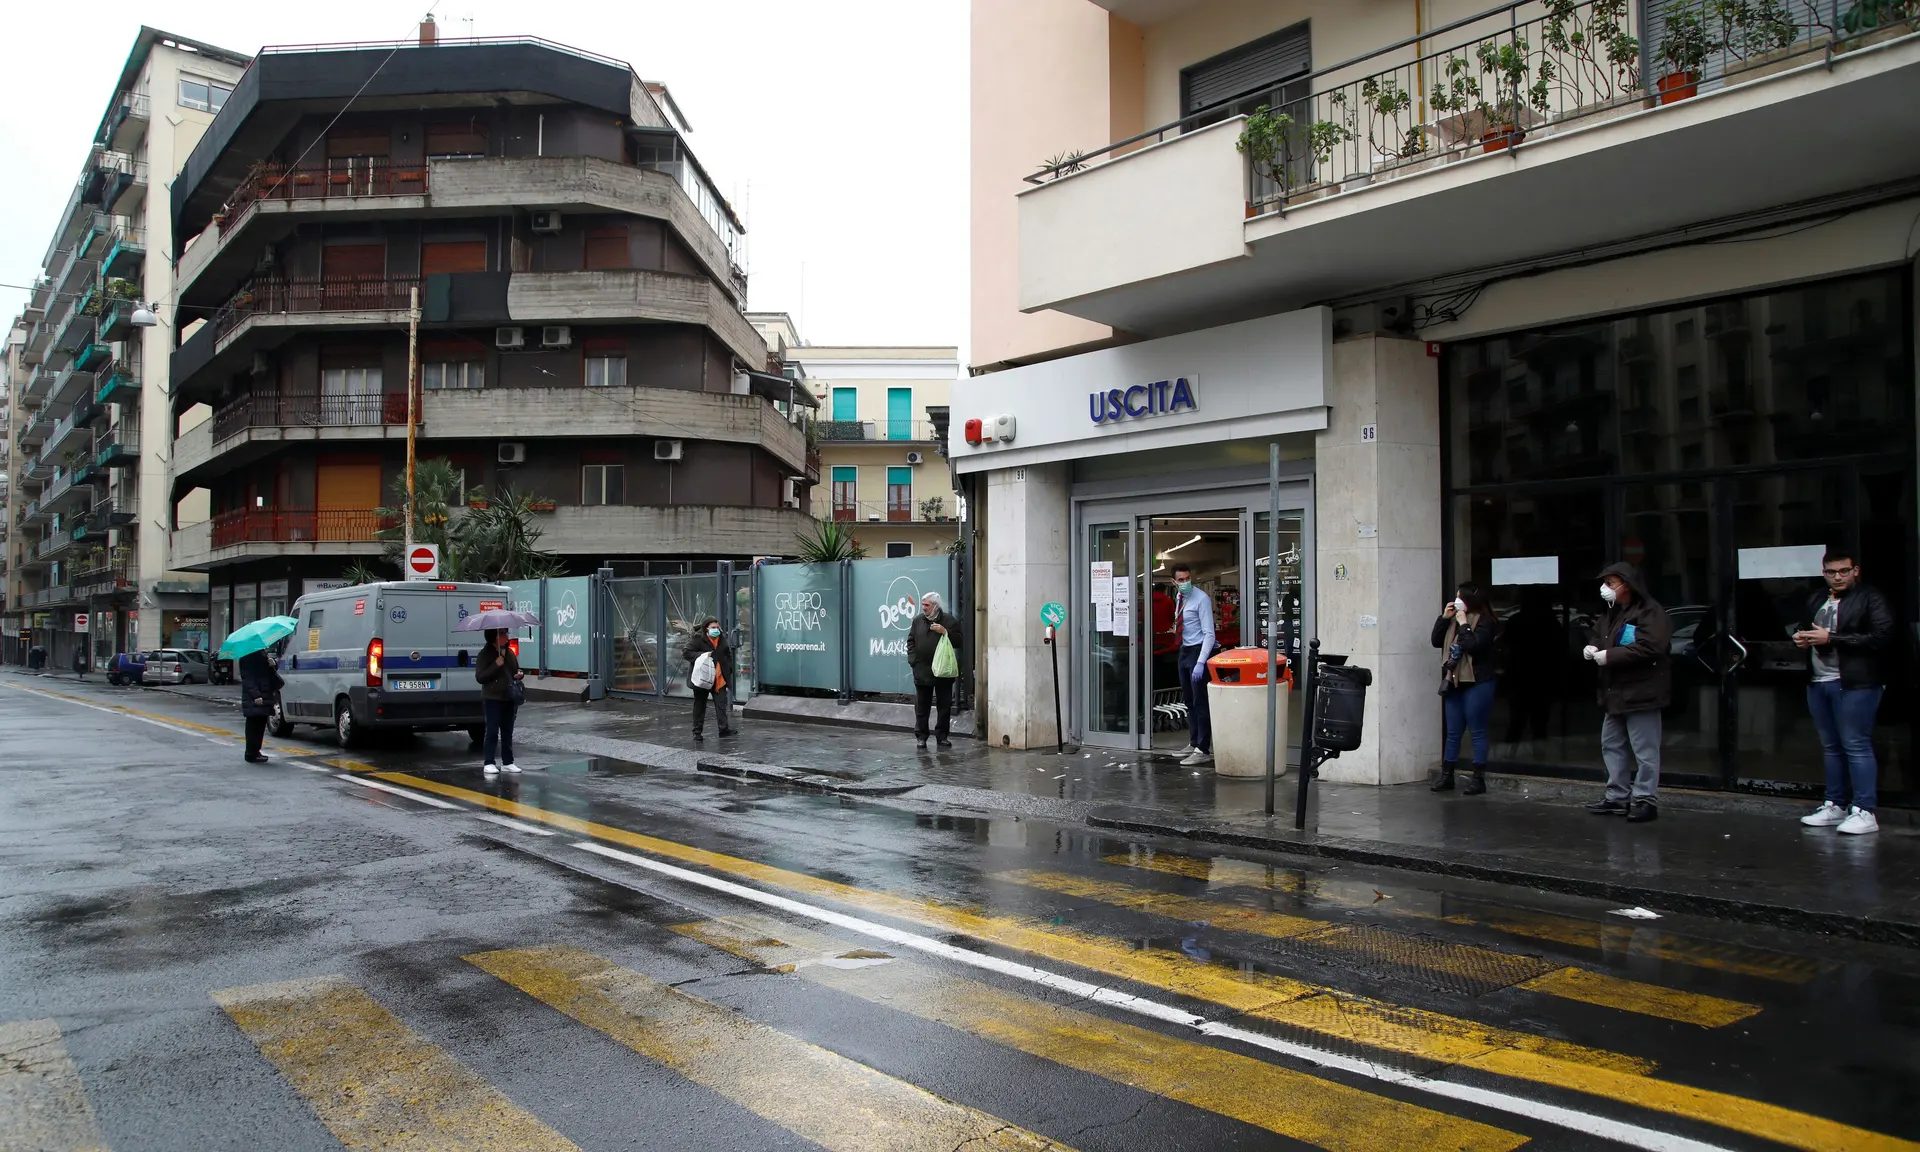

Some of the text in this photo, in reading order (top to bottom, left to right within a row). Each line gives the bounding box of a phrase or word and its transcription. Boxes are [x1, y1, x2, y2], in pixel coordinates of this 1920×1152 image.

[1089, 377, 1195, 423] USCITA
[1363, 427, 1374, 440] 96
[775, 592, 822, 610] GRUPPO
[392, 610, 407, 620] 642
[775, 641, 826, 653] gruppoarena.it
